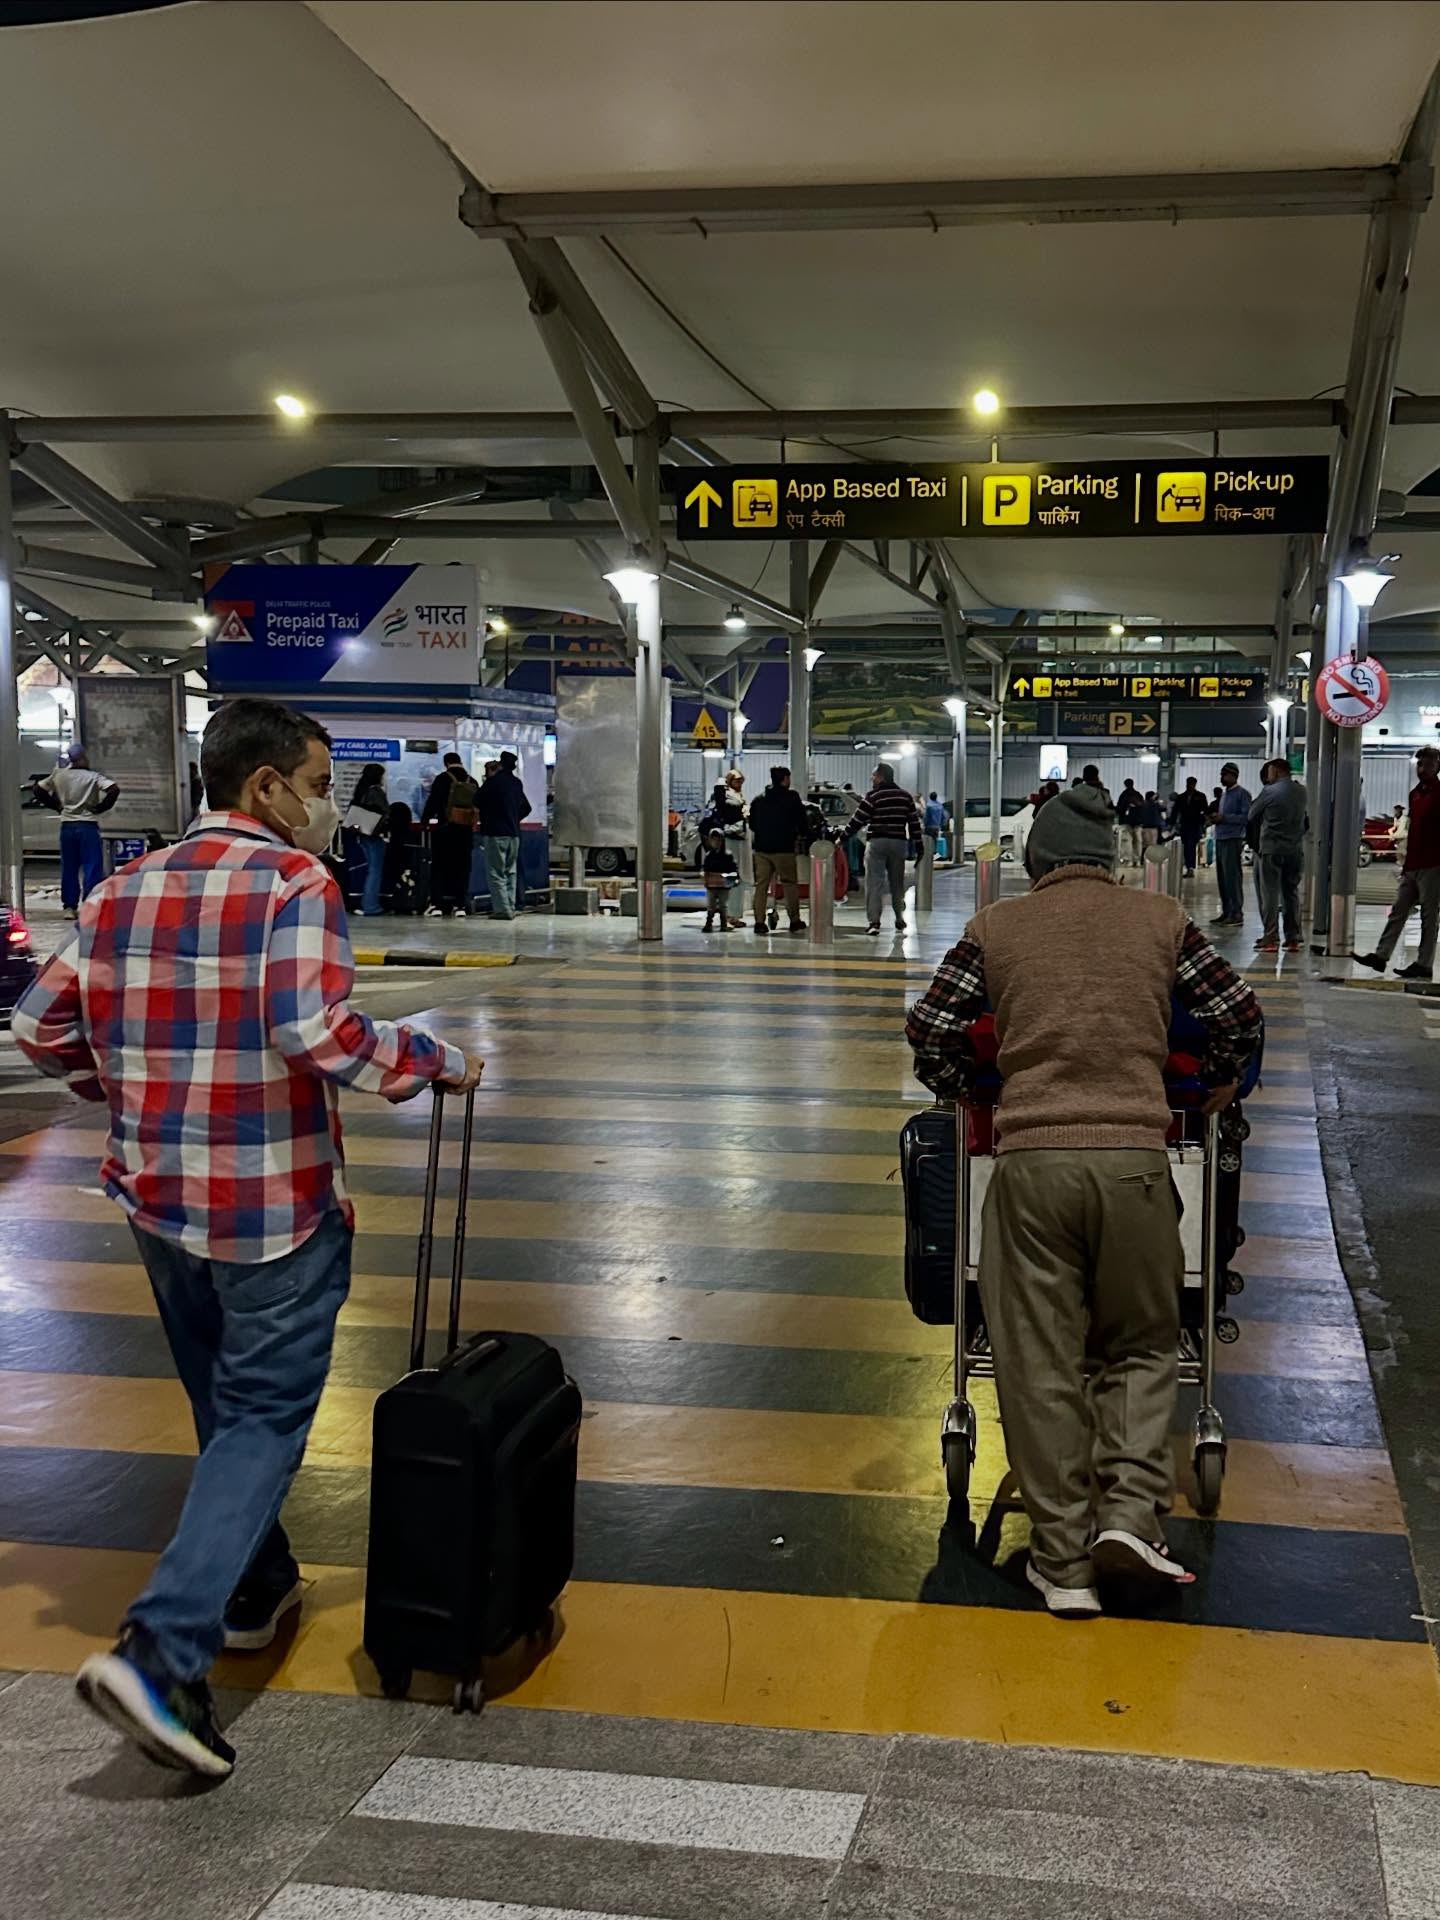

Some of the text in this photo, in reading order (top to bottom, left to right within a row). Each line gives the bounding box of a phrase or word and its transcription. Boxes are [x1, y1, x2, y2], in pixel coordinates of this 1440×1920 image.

[786, 476, 947, 502] App Based Taxi
[1037, 474, 1119, 499] Parking
[1214, 470, 1295, 495] Pick-up
[995, 484, 1018, 517] P
[1038, 505, 1080, 525] पार्किंग
[267, 612, 360, 631] Prepaid Taxi
[415, 605, 467, 625] भारत
[267, 631, 325, 647] Service
[417, 631, 467, 649] TAXI
[1320, 656, 1382, 680] NO SMING
[1054, 677, 1119, 687] App Based Taxi
[1153, 677, 1186, 688] Parking
[1064, 711, 1106, 725] Parking
[1326, 702, 1383, 725] NO SMOKING
[702, 726, 716, 738] 15
